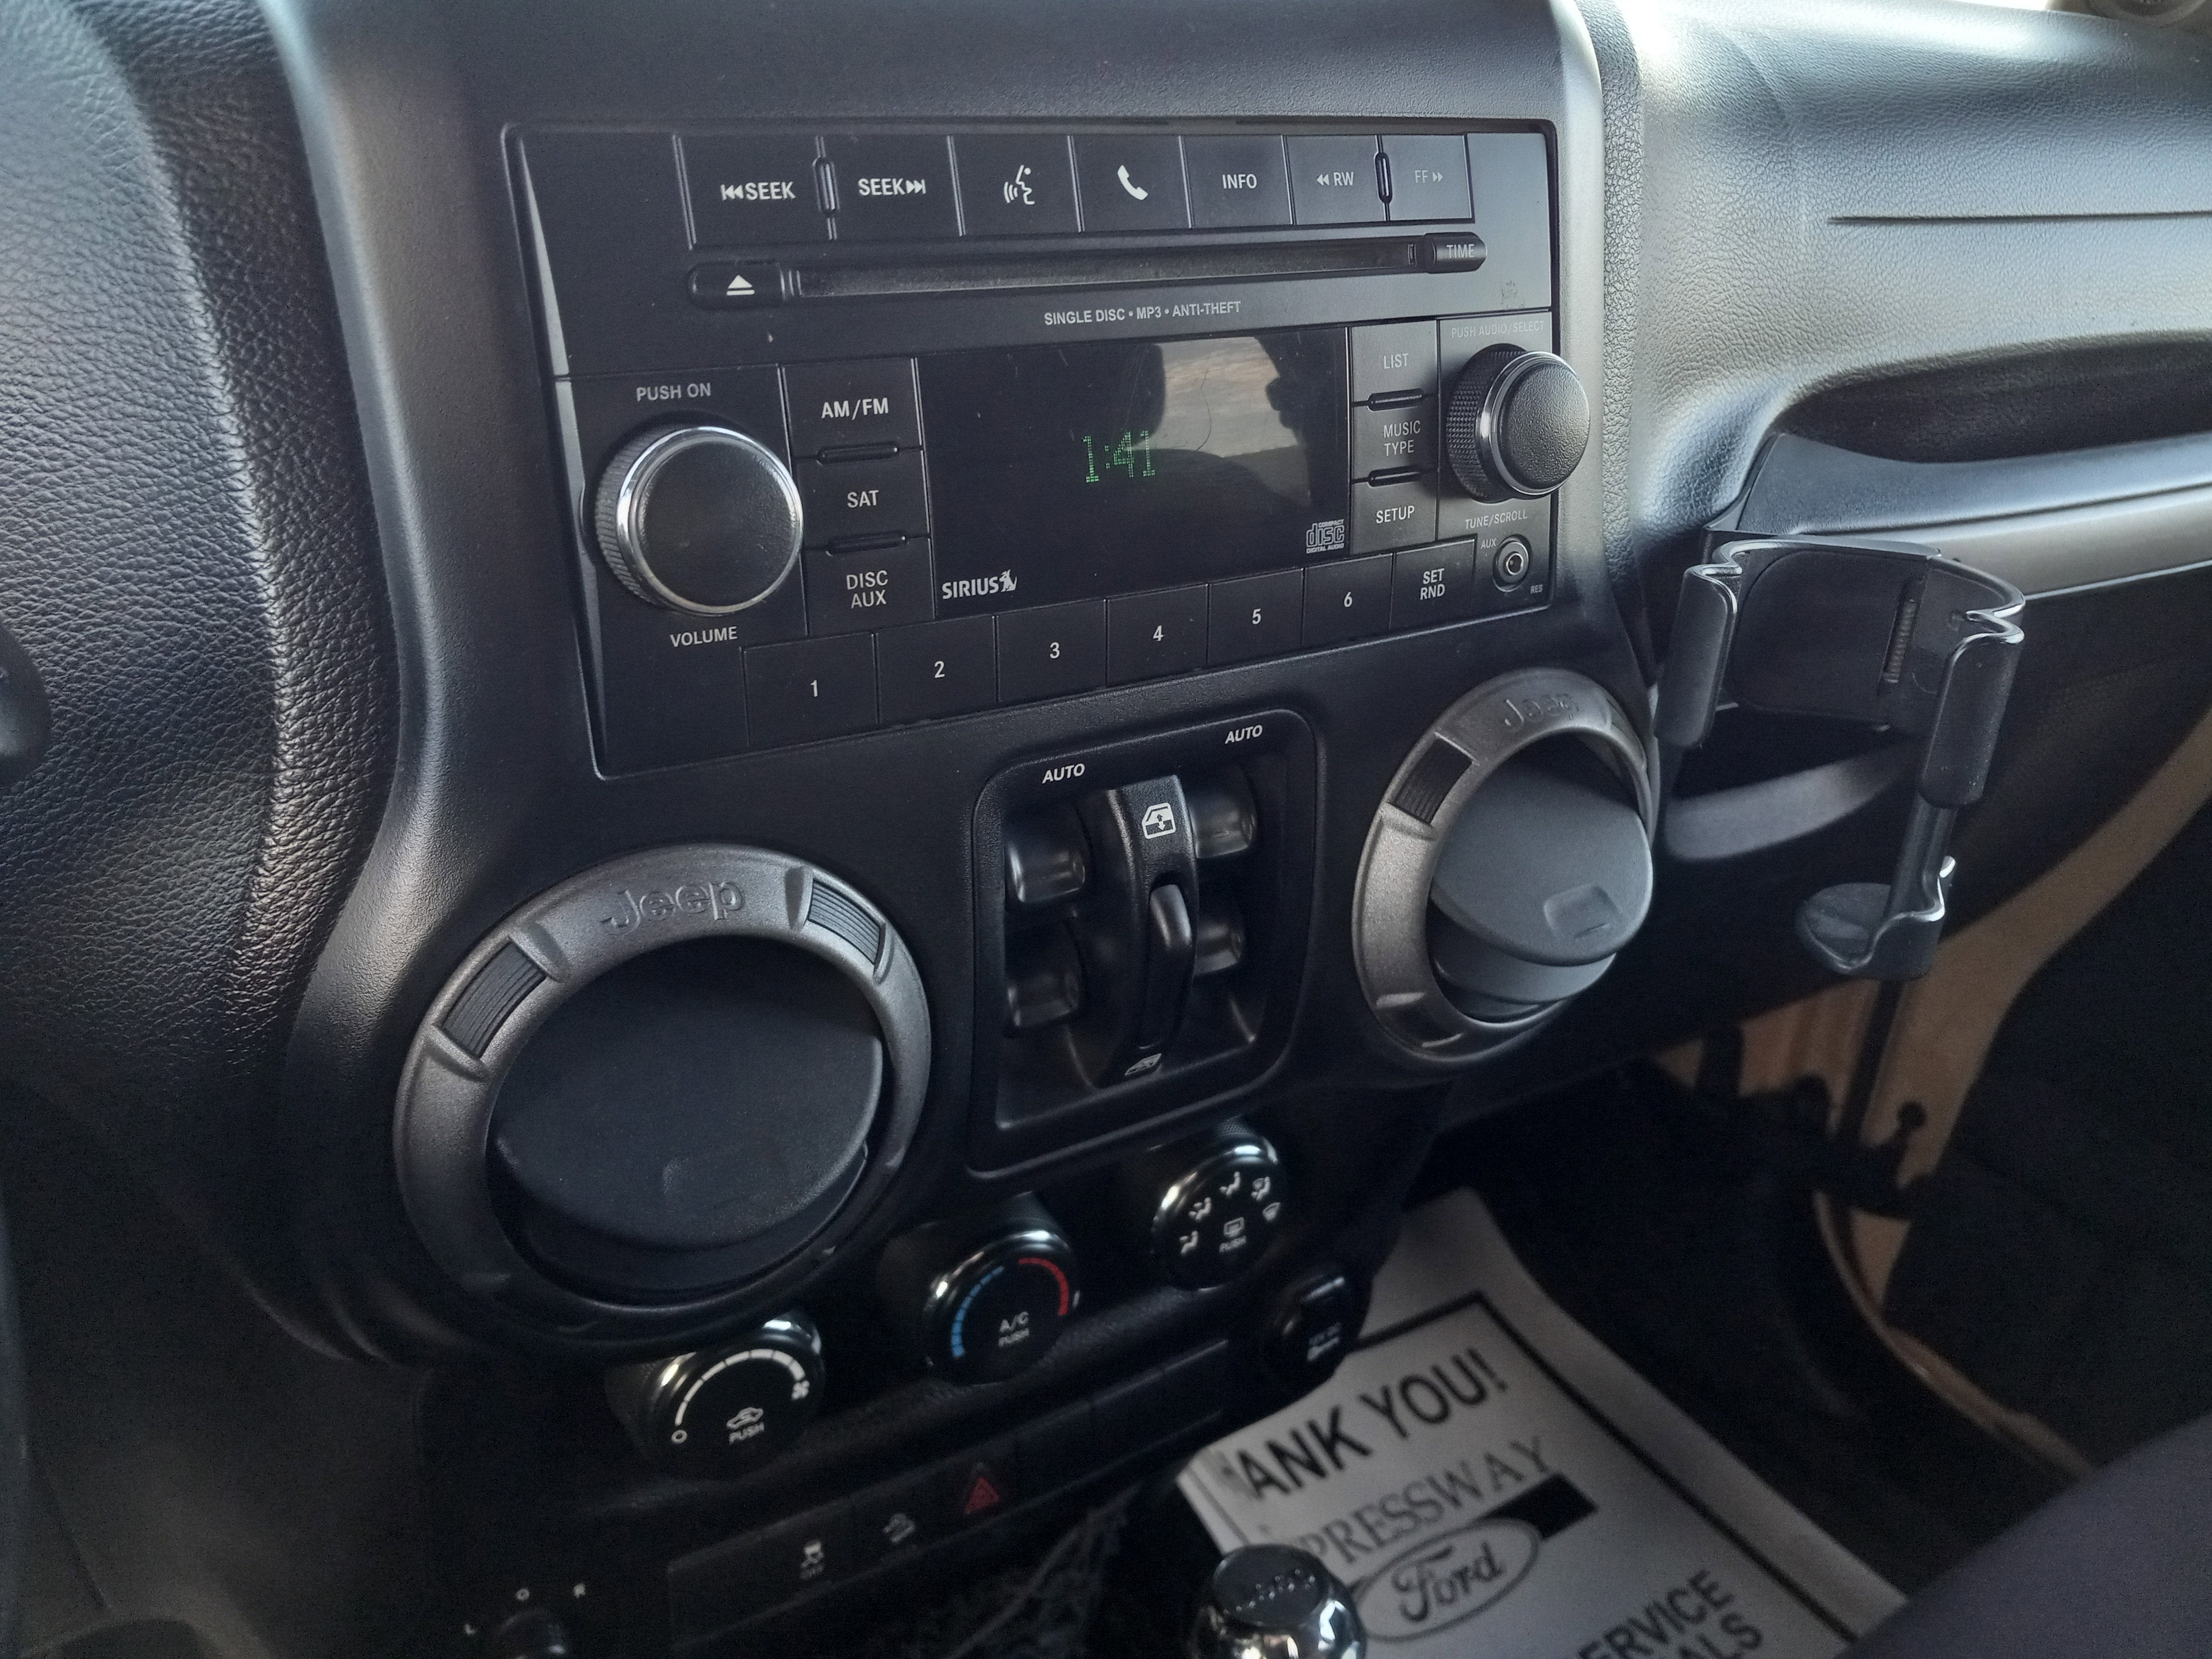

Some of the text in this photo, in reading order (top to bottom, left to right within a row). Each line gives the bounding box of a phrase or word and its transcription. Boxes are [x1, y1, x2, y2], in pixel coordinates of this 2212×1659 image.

[1222, 173, 1258, 189] INFO
[1333, 171, 1354, 187] RW
[1414, 169, 1429, 184] FF
[745, 181, 796, 200] SEEK
[858, 178, 905, 196] SEEK
[1446, 243, 1476, 259] TIME
[1044, 300, 1242, 325] SINGLE DISC MP3 ANTI-THEFT
[1451, 320, 1545, 338] PUSH AUDIO/SELECT
[1383, 352, 1409, 370] LIST
[636, 382, 712, 402] PUSH ON
[821, 397, 889, 421] AM/FM
[1383, 420, 1421, 438] MUSIC
[1083, 430, 1155, 483] 1:41
[1383, 439, 1414, 457] TYPE
[847, 489, 879, 508] SAT
[1318, 519, 1345, 528] COMPACT
[1375, 505, 1415, 524] SETUP
[1464, 509, 1528, 530] TUNE/SCROLL
[1480, 538, 1497, 550] AUX
[846, 569, 889, 590] DISC
[1422, 567, 1445, 584] SET
[941, 576, 999, 600] SIRIUS
[1419, 584, 1445, 601] RND
[1530, 584, 1543, 594] RES
[850, 590, 887, 609] AUX
[1344, 591, 1353, 608] 6
[1252, 608, 1262, 625] 5
[670, 625, 738, 648] VOLUME
[1153, 625, 1164, 642] 4
[1049, 641, 1060, 659] 3
[934, 660, 946, 679] 2
[810, 679, 818, 697] 1
[1224, 724, 1263, 745] AUTO
[1041, 762, 1086, 784] AUTO
[600, 881, 744, 935] Jeep
[1235, 1347, 1508, 1501] ANK YOU!
[1298, 1435, 1551, 1563] PRESSWAY
[1393, 1541, 1506, 1623] Ford
[1578, 1570, 1735, 1659] ERVICE
